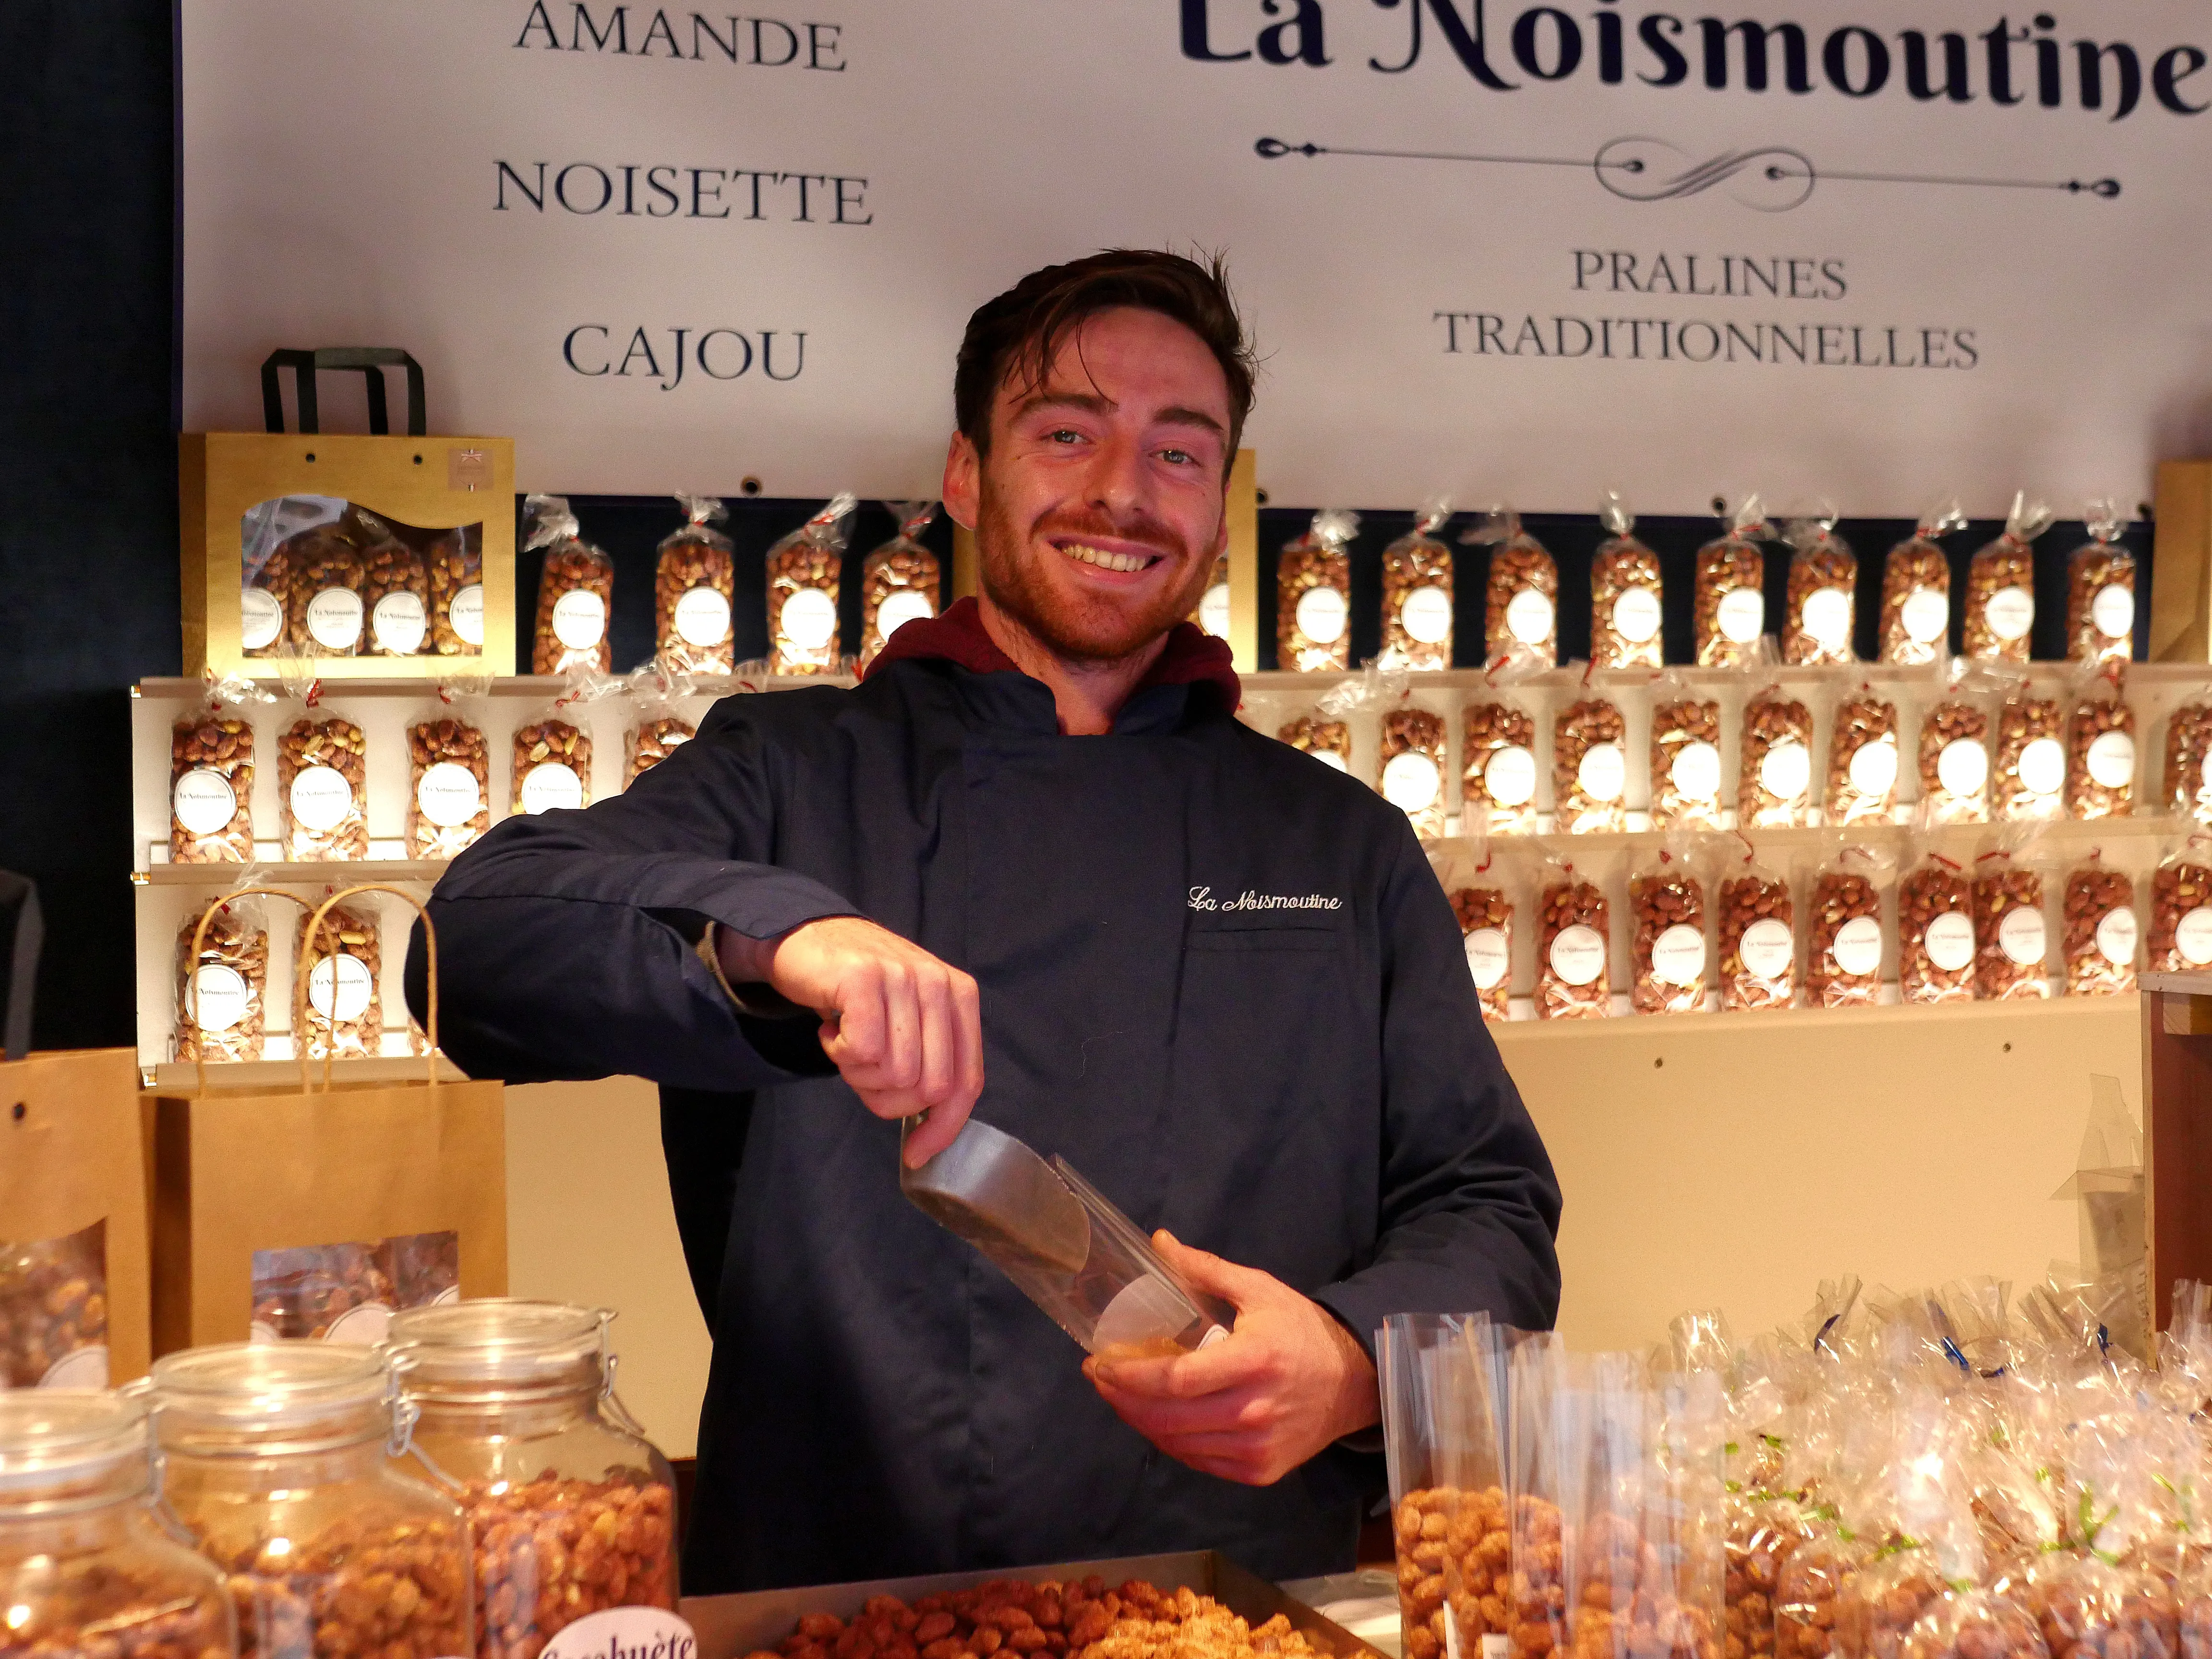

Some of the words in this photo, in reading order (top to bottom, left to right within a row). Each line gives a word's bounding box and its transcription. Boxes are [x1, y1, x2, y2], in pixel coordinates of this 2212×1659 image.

[513, 0, 847, 72] AMANDE
[1178, 0, 1334, 69] La
[1368, 0, 2212, 123] Noismoutine
[493, 160, 874, 226] NOISETTE
[1573, 249, 1848, 299] PRALINES
[563, 325, 808, 392] CAJOU
[1433, 312, 1979, 368] TRADITIONNELLES
[1187, 886, 1218, 912] La
[1221, 890, 1343, 912] Noismoutine
